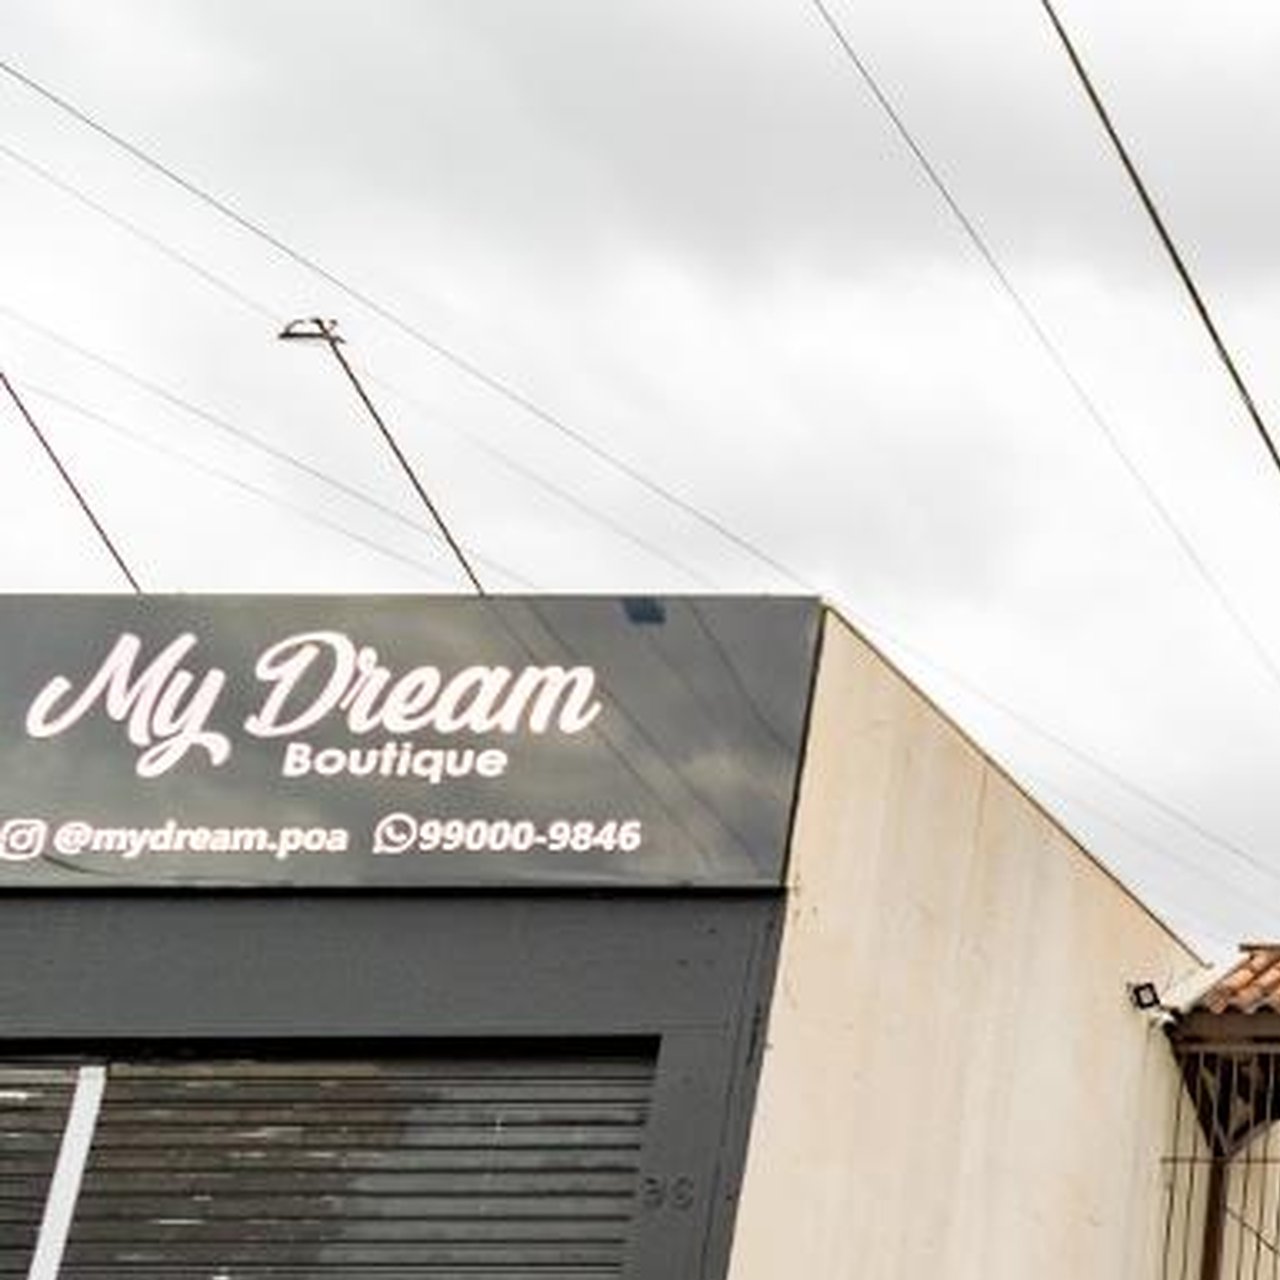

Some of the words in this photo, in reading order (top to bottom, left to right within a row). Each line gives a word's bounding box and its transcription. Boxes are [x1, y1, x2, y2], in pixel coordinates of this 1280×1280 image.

[26, 633, 230, 778] My
[244, 631, 602, 738] Dream
[281, 742, 508, 784] Boutique
[54, 819, 349, 861] @mydream.poa
[418, 820, 642, 851] 99000-9846
